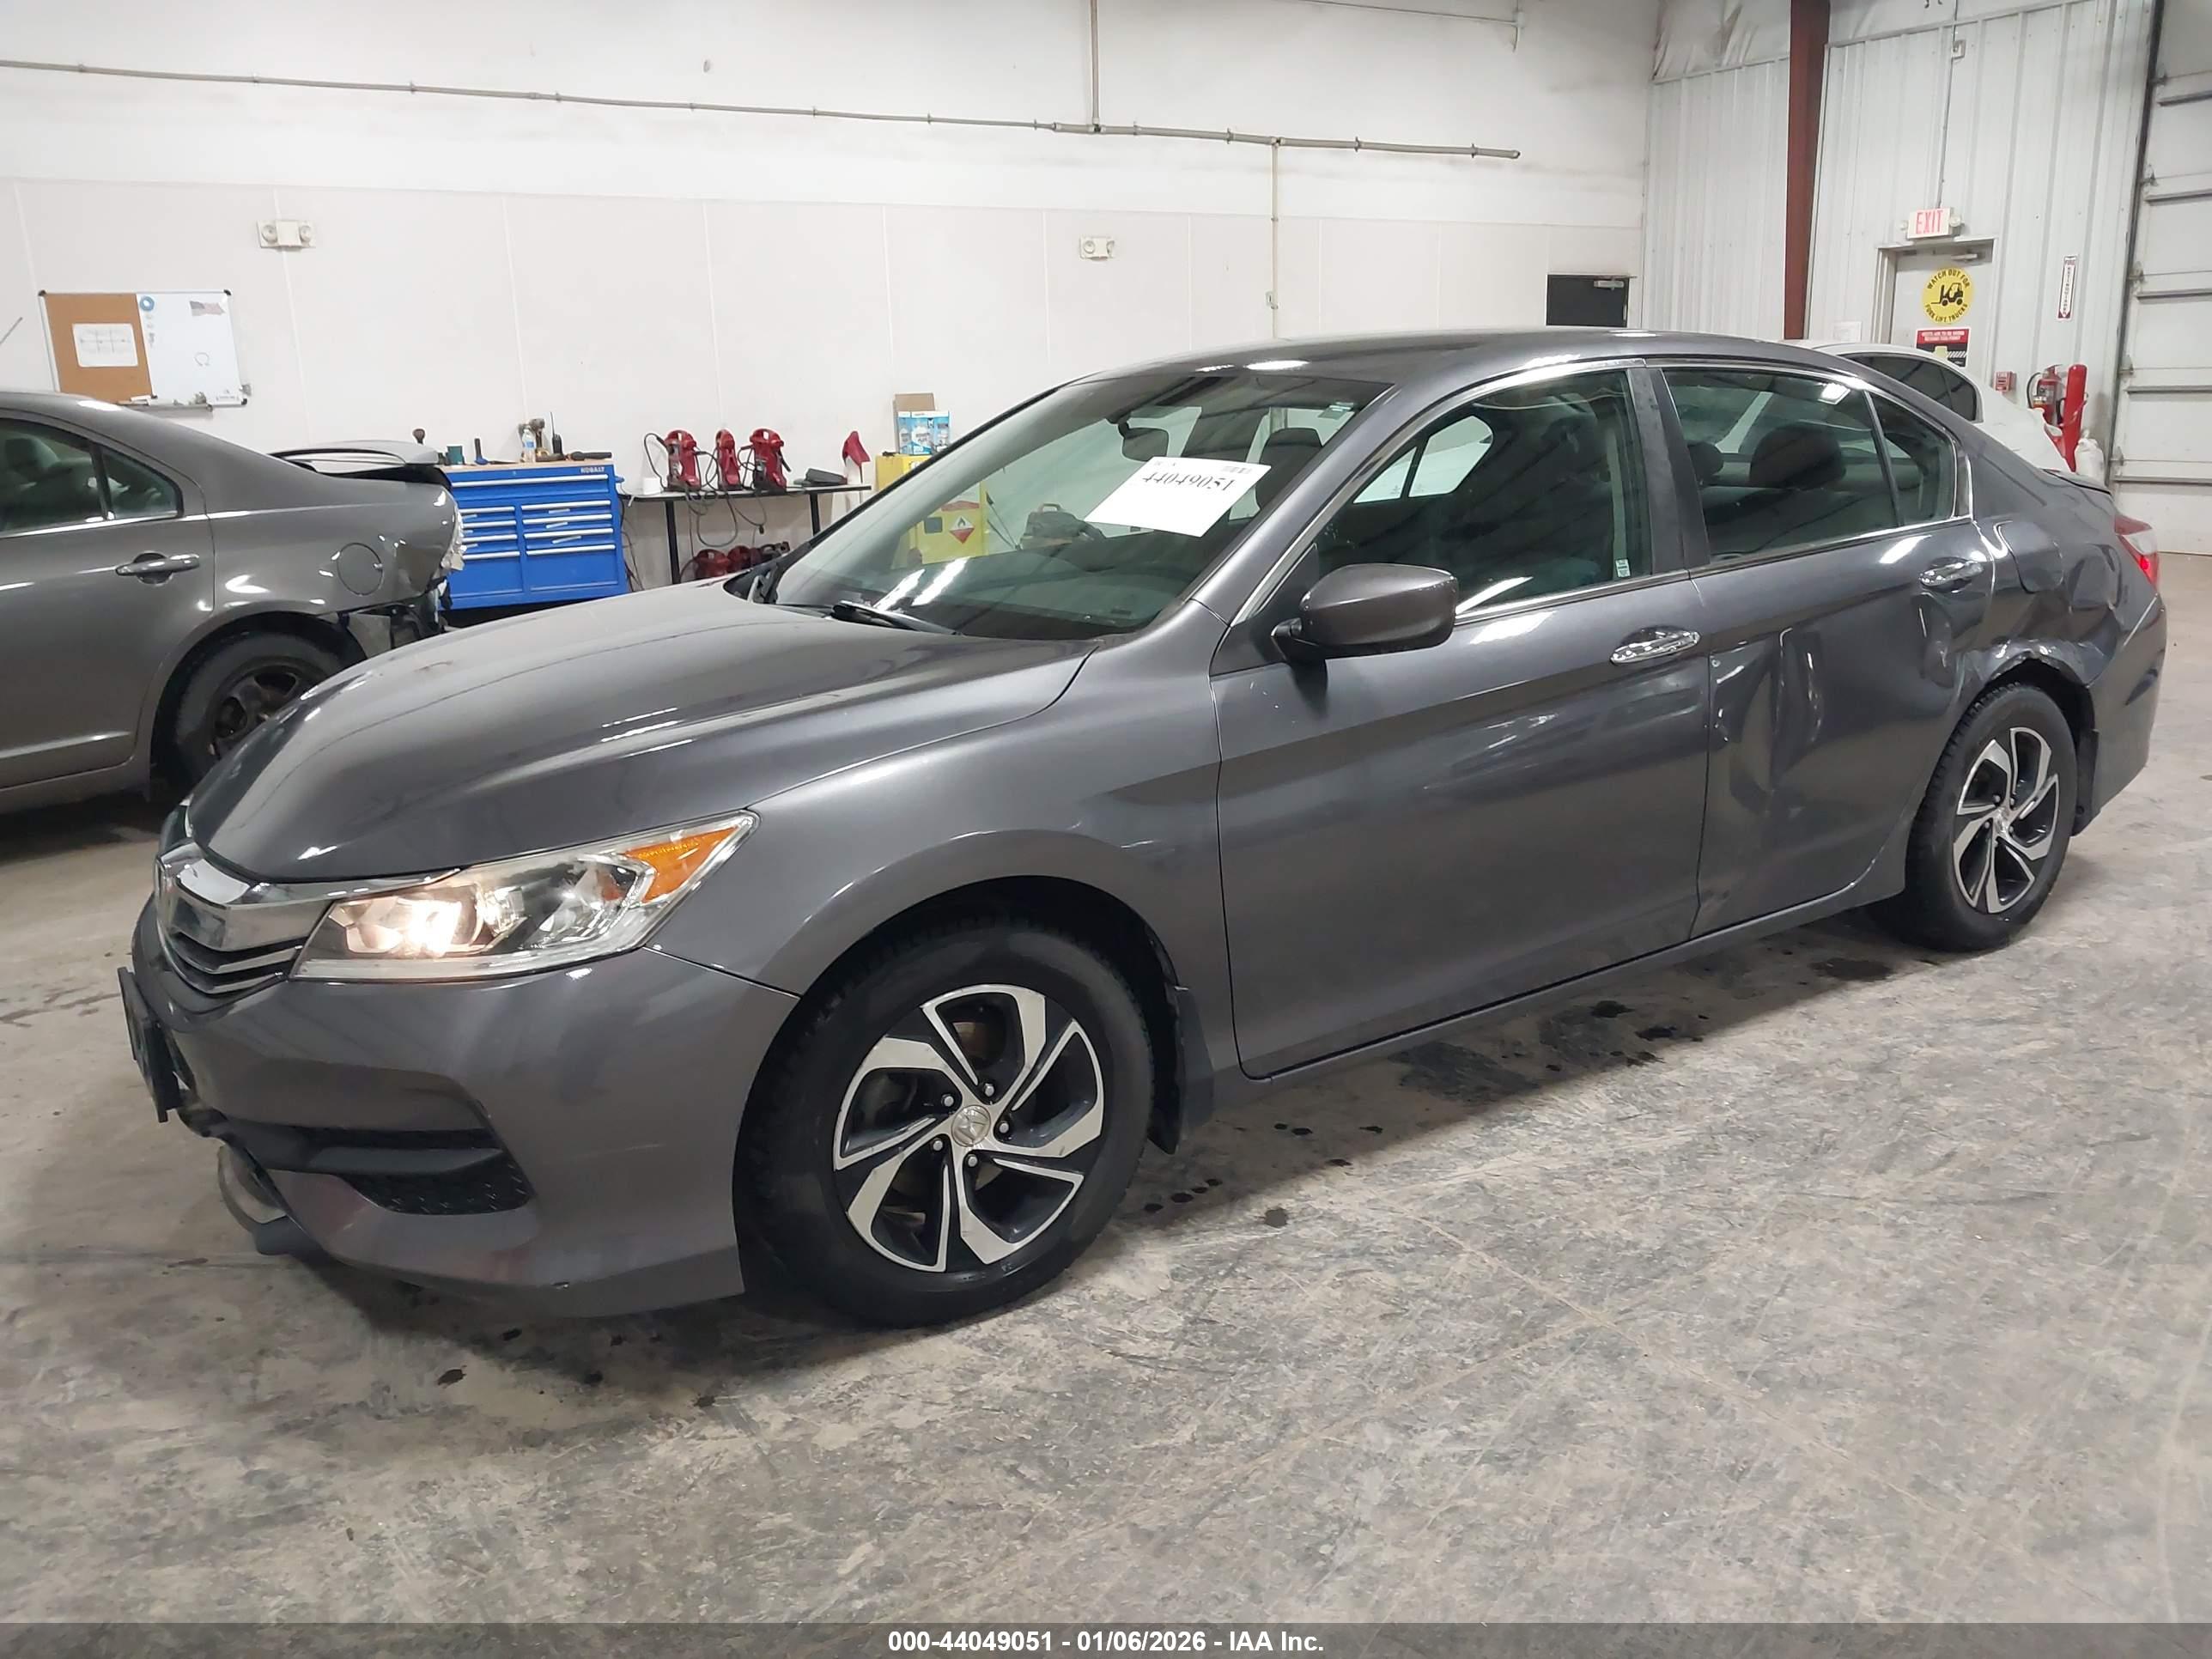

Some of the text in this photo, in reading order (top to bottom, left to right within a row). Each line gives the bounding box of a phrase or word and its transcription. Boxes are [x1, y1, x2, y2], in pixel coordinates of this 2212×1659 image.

[1916, 210, 1943, 234] EXIT
[1927, 269, 1970, 289] WATCH OUT FOR
[1924, 304, 1936, 319] FORK
[1948, 303, 1967, 322] TRUCKS
[1142, 472, 1236, 490] 44049051
